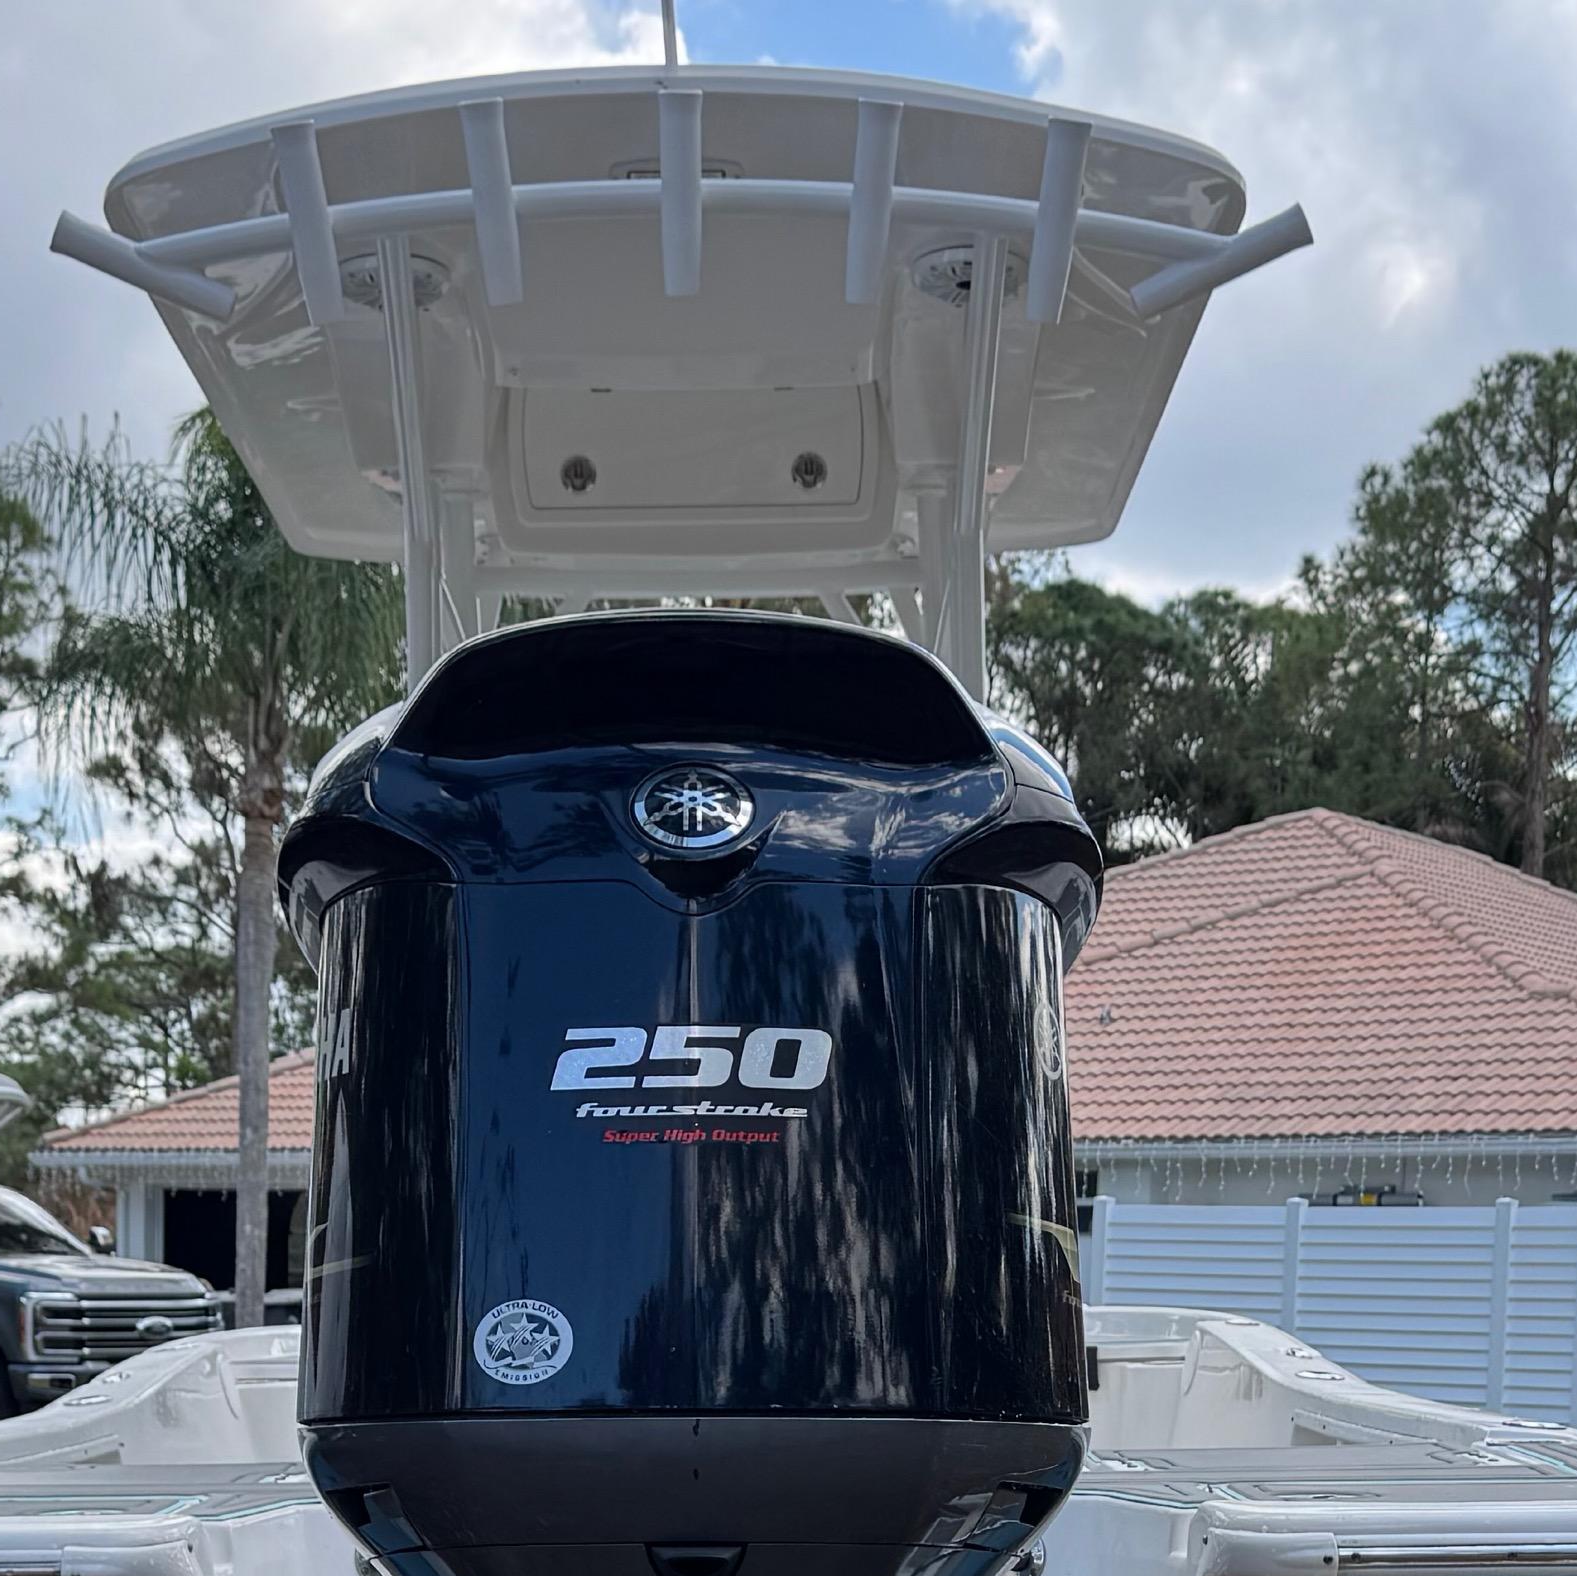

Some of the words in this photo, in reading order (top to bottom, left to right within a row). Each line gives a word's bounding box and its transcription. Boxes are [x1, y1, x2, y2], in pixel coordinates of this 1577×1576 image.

[550, 1025, 833, 1091] 250
[602, 1130, 659, 1144] Super
[663, 1129, 707, 1144] High
[711, 1129, 780, 1144] Output
